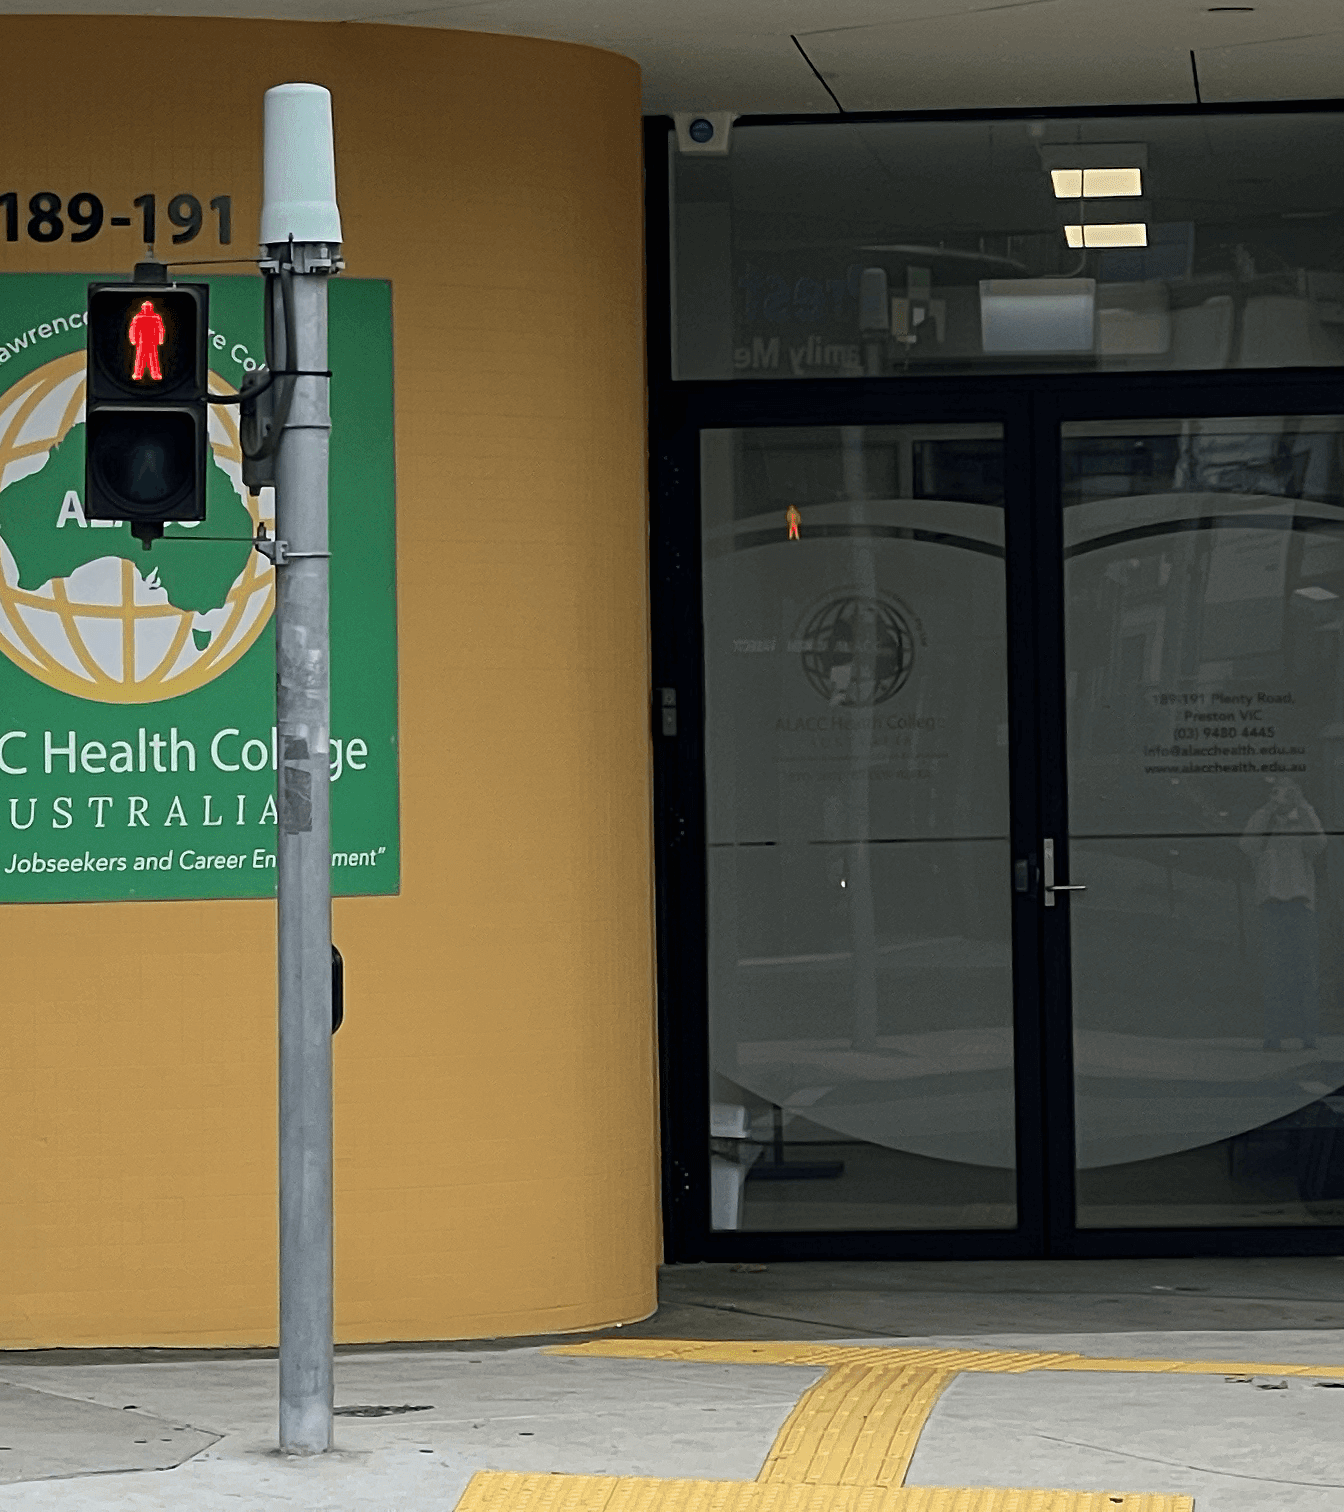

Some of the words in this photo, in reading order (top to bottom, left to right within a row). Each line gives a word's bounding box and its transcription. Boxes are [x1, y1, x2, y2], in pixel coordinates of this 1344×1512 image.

[1211, 692, 1254, 707] Plenty
[1183, 710, 1236, 722] Preston
[1239, 708, 1263, 721] VIC
[775, 716, 828, 732] ALACC
[1173, 726, 1199, 741] (03)
[1203, 726, 1237, 739] 9480
[1241, 725, 1275, 739] 4445
[43, 727, 197, 774] Health
[210, 726, 369, 782] Colge
[1143, 760, 1307, 774] www.alacchealth.edu.au
[4, 851, 127, 874] Jobseekers
[133, 850, 174, 871] and
[179, 849, 247, 871] Career
